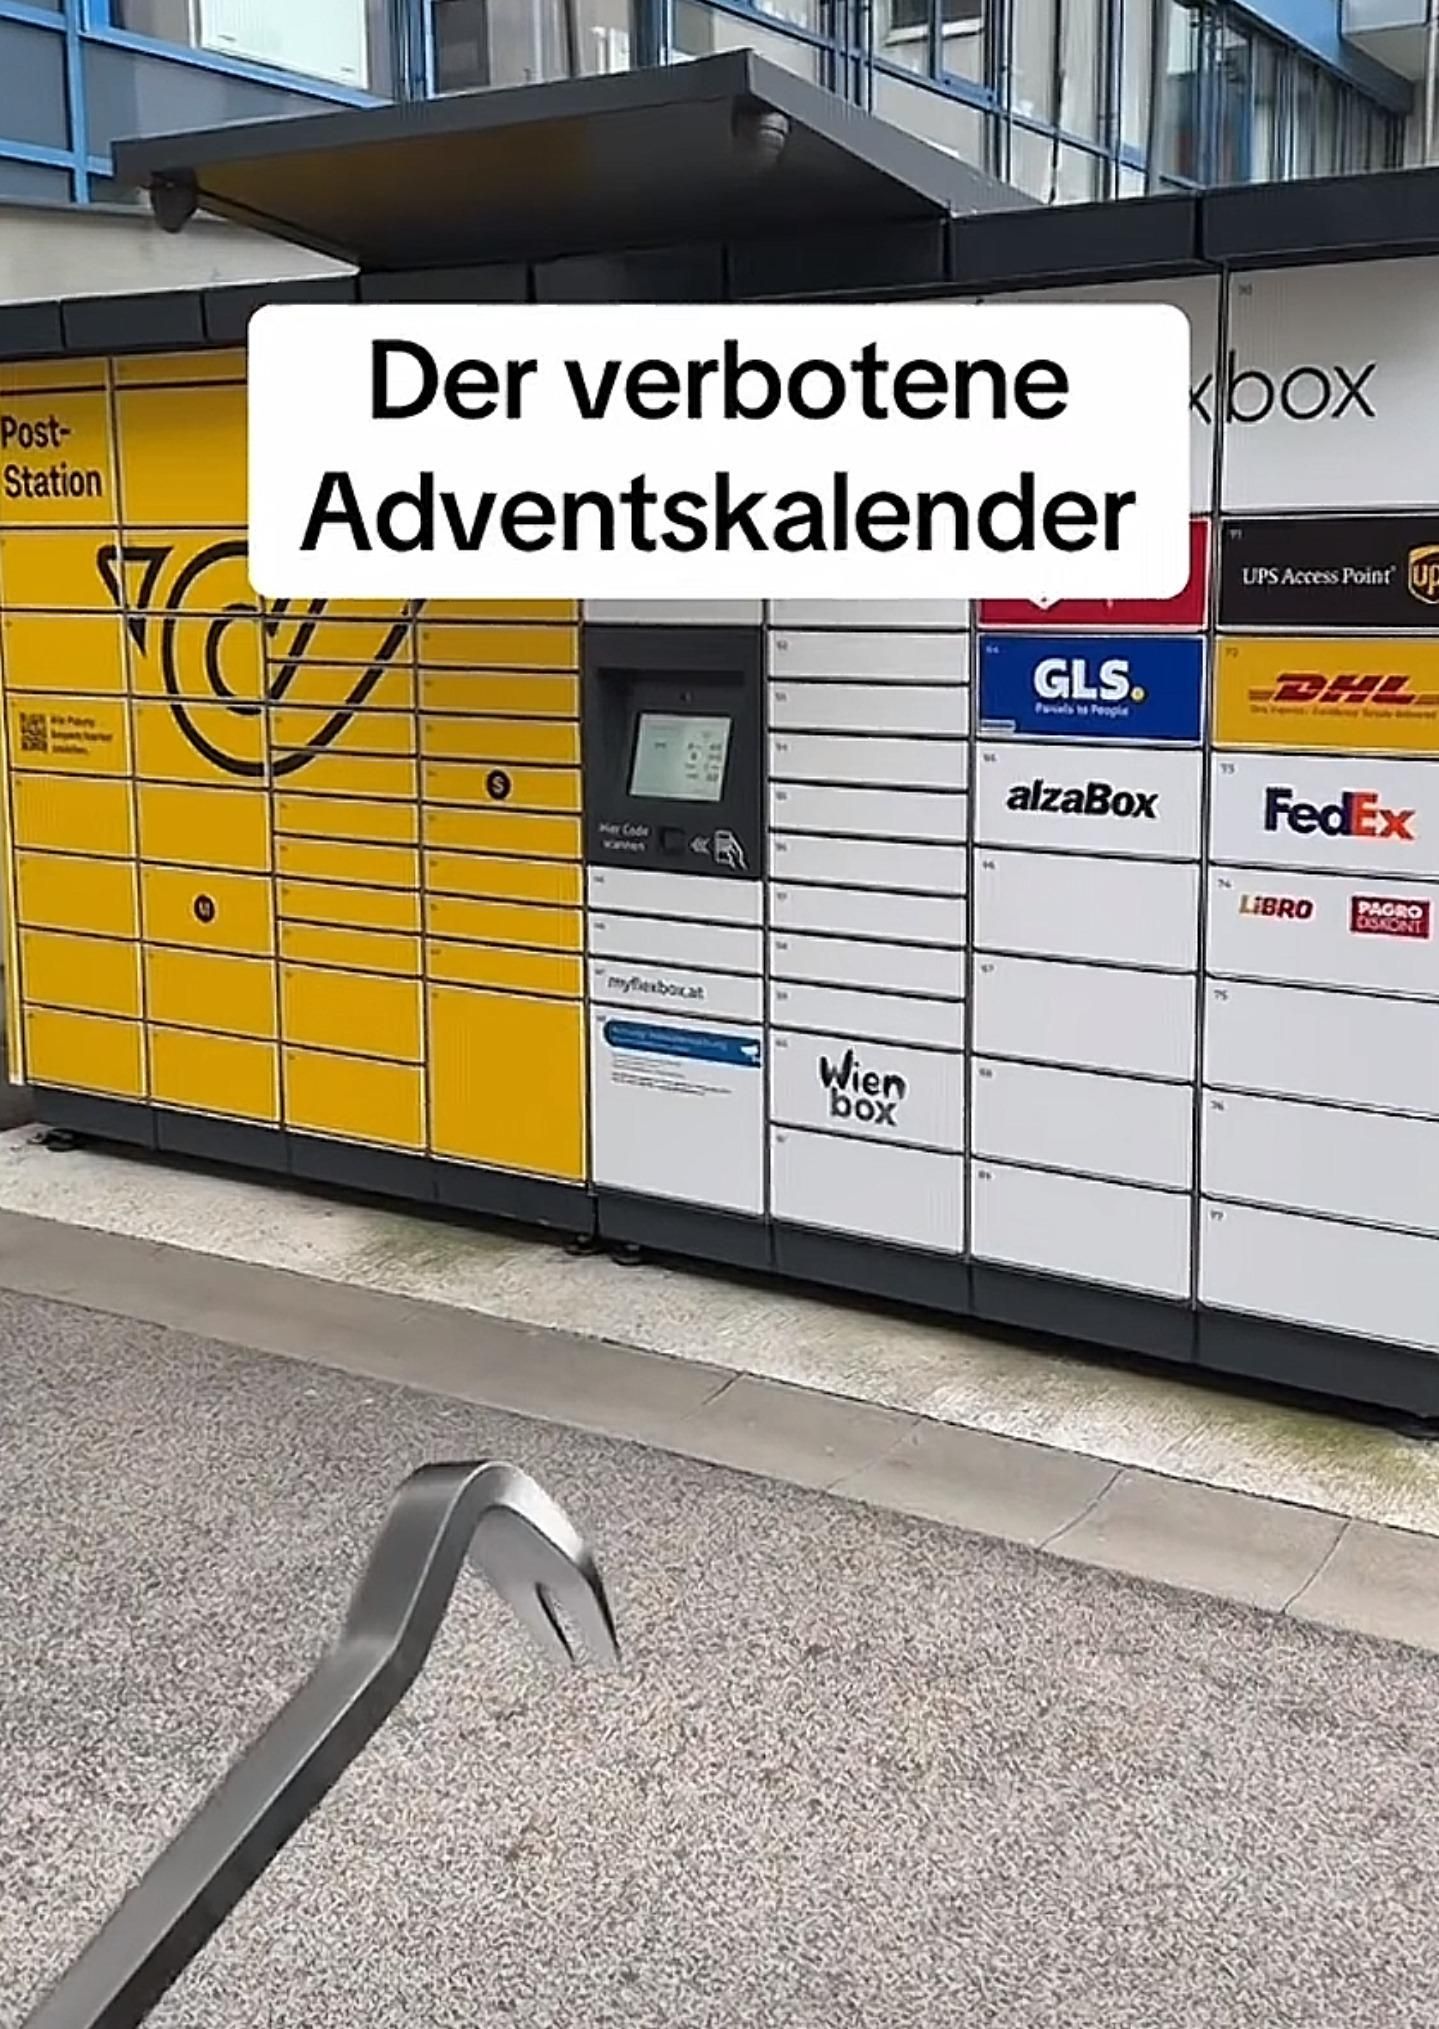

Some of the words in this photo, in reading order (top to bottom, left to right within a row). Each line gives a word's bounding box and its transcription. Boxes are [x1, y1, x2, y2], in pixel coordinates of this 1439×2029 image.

[2, 414, 71, 448] Post-
[4, 461, 103, 498] Station
[1242, 566, 1279, 586] UPS
[1281, 566, 1340, 586] Access
[1273, 673, 1416, 704] DHL
[492, 775, 505, 793] S
[1007, 778, 1159, 819] alzaBox
[1265, 787, 1416, 840] FedEx
[1358, 901, 1424, 919] PAGRO
[819, 1048, 906, 1100] Wien
[831, 1087, 897, 1127] box
